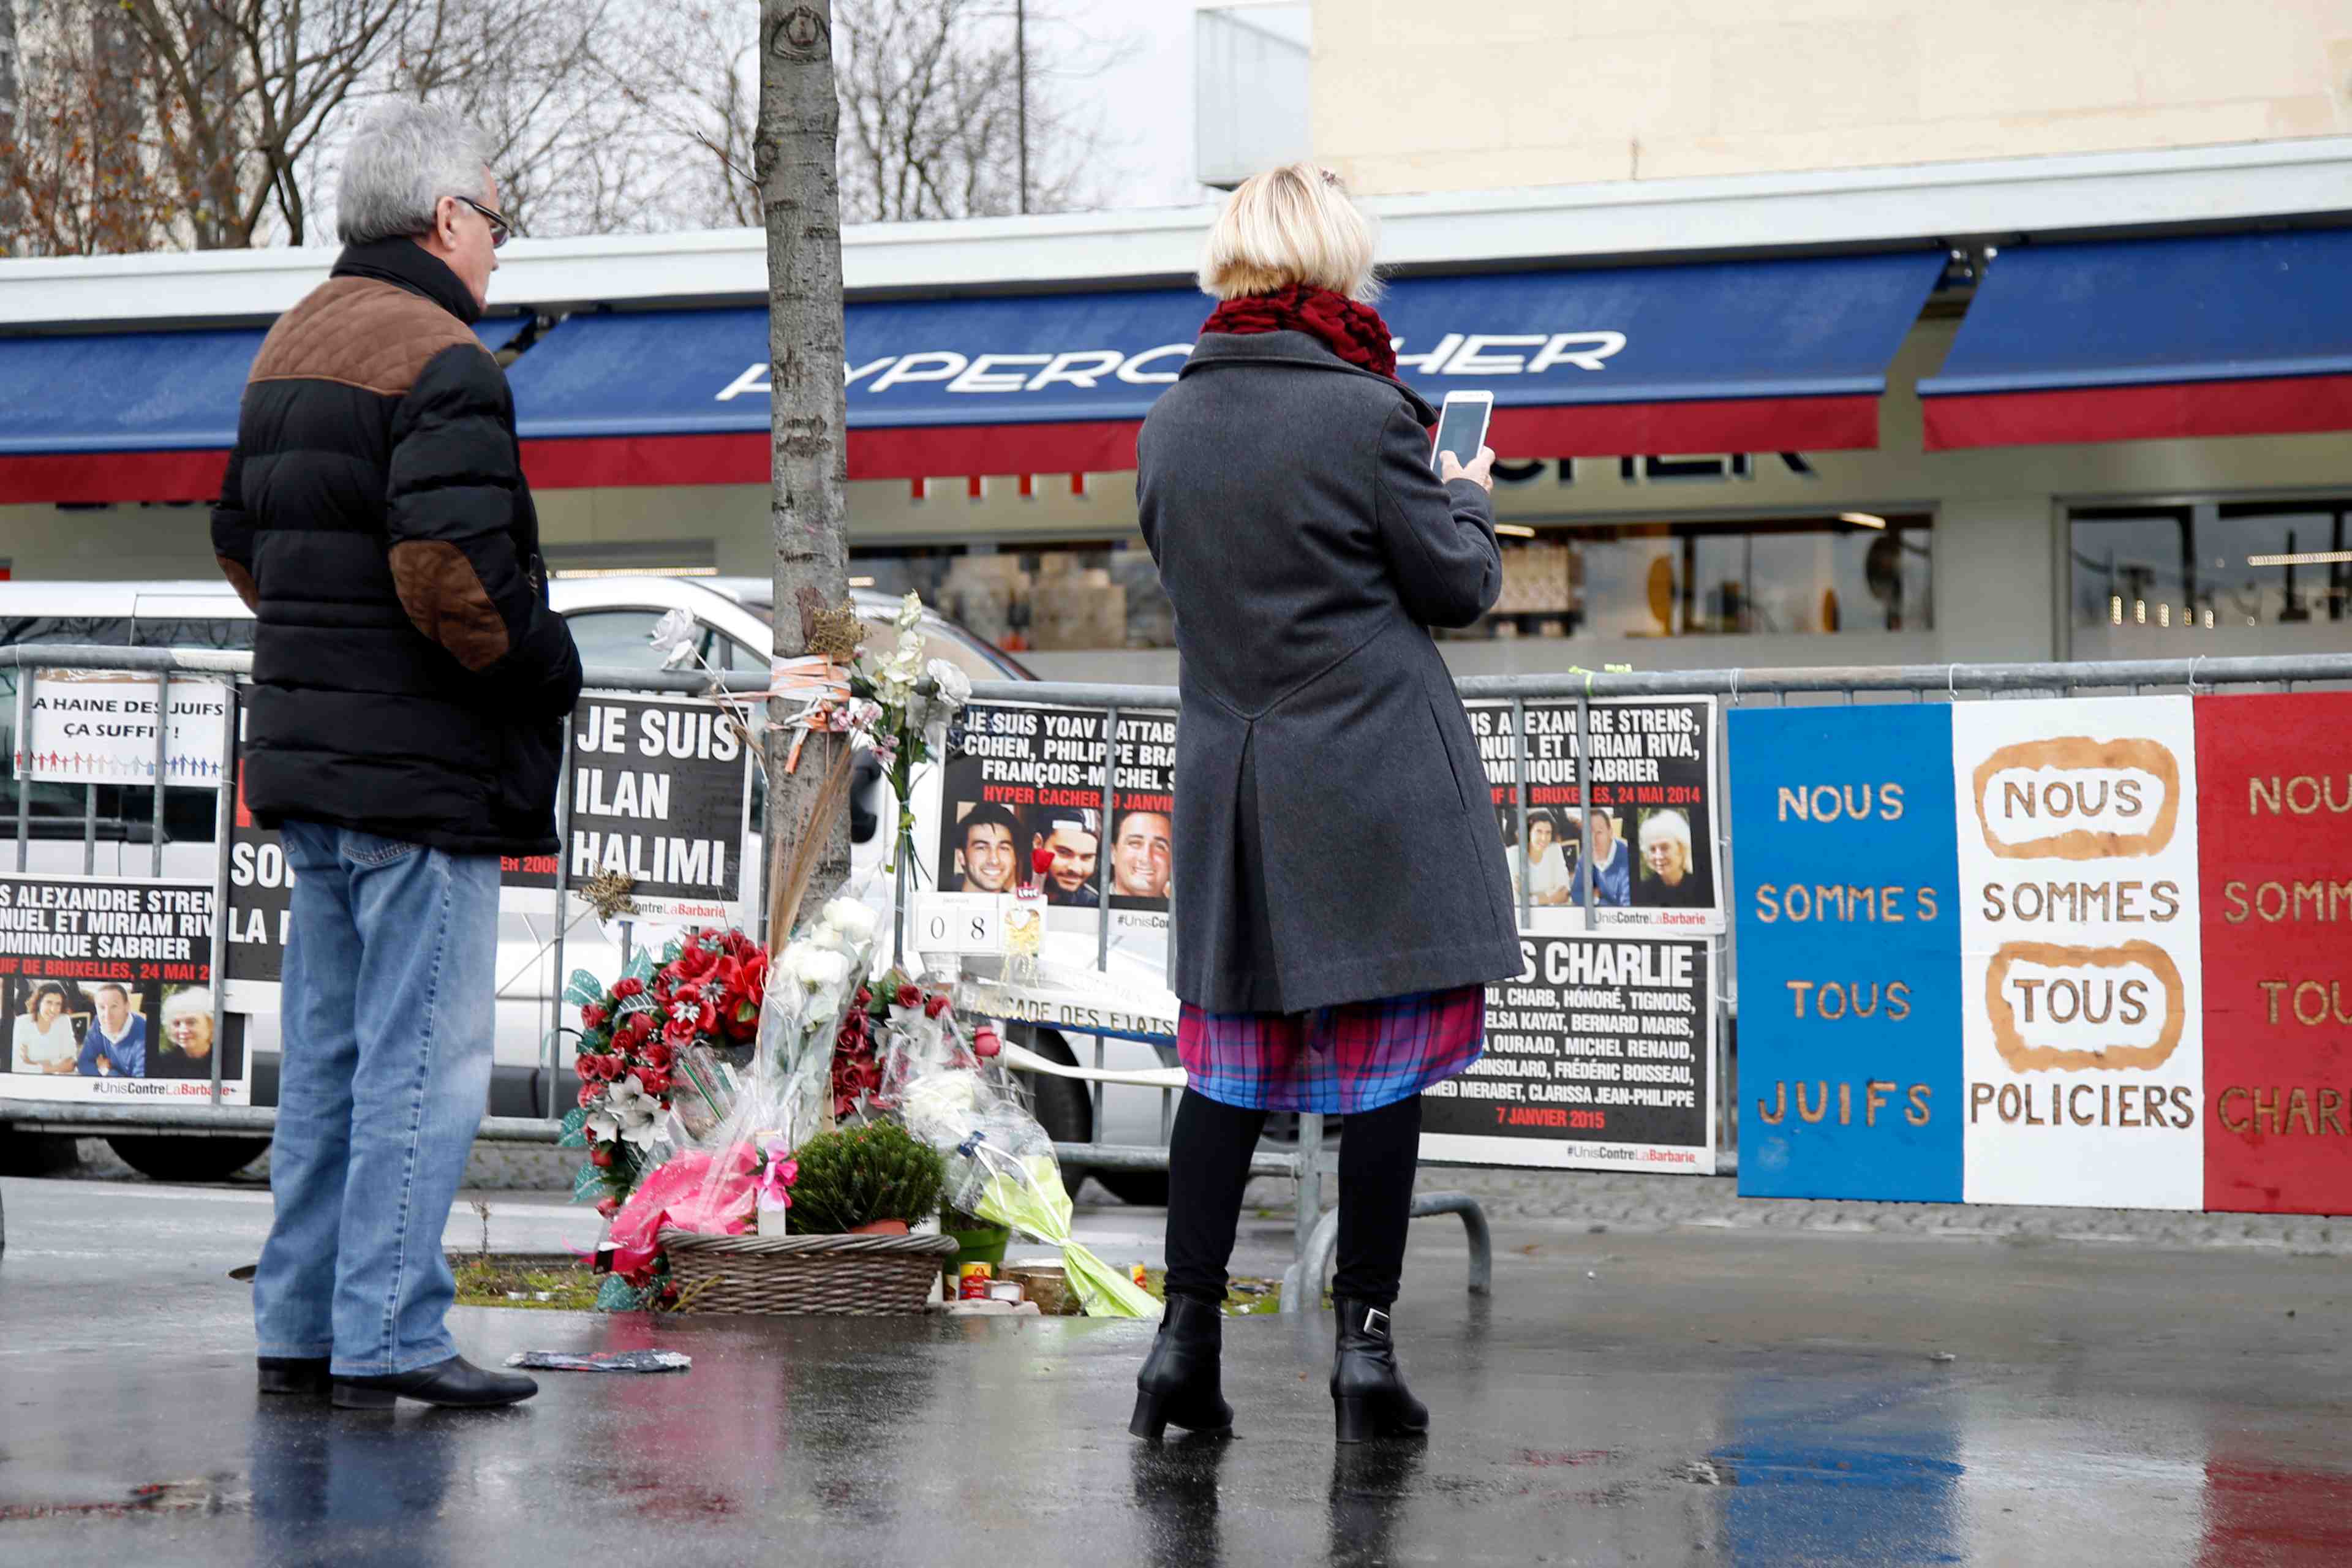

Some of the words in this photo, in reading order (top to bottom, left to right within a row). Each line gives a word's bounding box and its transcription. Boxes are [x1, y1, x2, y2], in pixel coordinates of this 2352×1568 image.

[32, 698, 47, 710] A
[53, 698, 118, 712] HAINE
[169, 702, 224, 715] JUIFS
[64, 723, 91, 737] ÇA
[96, 725, 168, 737] SUFFI
[576, 705, 627, 754] JE
[639, 709, 739, 761] SUIS
[963, 711, 987, 732] JE
[992, 712, 1038, 735] SUIS
[1044, 715, 1097, 739] YOAV
[1498, 710, 1613, 734] AEXANRE
[1618, 708, 1700, 736] STRENS,
[964, 734, 1036, 762] COHEN,
[1539, 734, 1564, 758] ET
[1647, 733, 1700, 761] RIVA,
[982, 760, 1163, 790] FRANÇOIS-MCHEL
[1588, 758, 1659, 782] ABRIER
[575, 767, 670, 820] ILAN
[983, 785, 1035, 804] HYPER
[1618, 785, 1635, 804] 24
[1637, 786, 1664, 804] MAI
[1667, 785, 1701, 804] 2014
[1777, 782, 1905, 823] NOUS
[2004, 780, 2143, 819] NOUS
[571, 830, 725, 886] HALIMI
[17, 885, 140, 912] ALEXANDRE
[1755, 883, 1937, 923] SOMMES
[1982, 880, 2180, 922] SOMMES
[55, 910, 81, 933] ET
[87, 911, 173, 936] MIRIAM
[228, 907, 268, 945] LA
[97, 935, 190, 960] SABRIER
[23, 958, 41, 974] DE
[45, 960, 134, 981] BRUXELLES,
[140, 963, 160, 979] 24
[164, 963, 195, 980] MAI
[1545, 941, 1693, 987] CHARLIE
[1507, 987, 1561, 1010] CHARB,
[1629, 991, 1696, 1014] TIGNOUS,
[1786, 980, 1912, 1021] TOUS
[2013, 978, 2149, 1025] TOUS
[1485, 1010, 1518, 1030] ELSA
[1520, 1012, 1568, 1034] KAYAT,
[1570, 1013, 1640, 1033] BERNARD
[1642, 1016, 1695, 1038] MARIS,
[1493, 1034, 1561, 1058] OURAAD,
[1565, 1037, 1624, 1057] MICHEL
[1627, 1039, 1695, 1063] RENAUD,
[1555, 1058, 1621, 1080] FRÉDÉRIC
[1623, 1063, 1695, 1087] BOISSEAU,
[1460, 1081, 1526, 1104] MERABET,
[1529, 1083, 1593, 1103] CLARISSA
[1594, 1086, 1695, 1108] JEAN-PHILIPPE
[1758, 1080, 1932, 1128] JUIFS
[1970, 1082, 2195, 1129] POLICIERS
[1496, 1106, 1507, 1125] 7
[1508, 1107, 1567, 1127] JANVIER
[1570, 1109, 1605, 1129] 2015
[2217, 1086, 2352, 1136] CHAR
[1567, 1144, 1695, 1164] #UnisContreLaBarbarie
